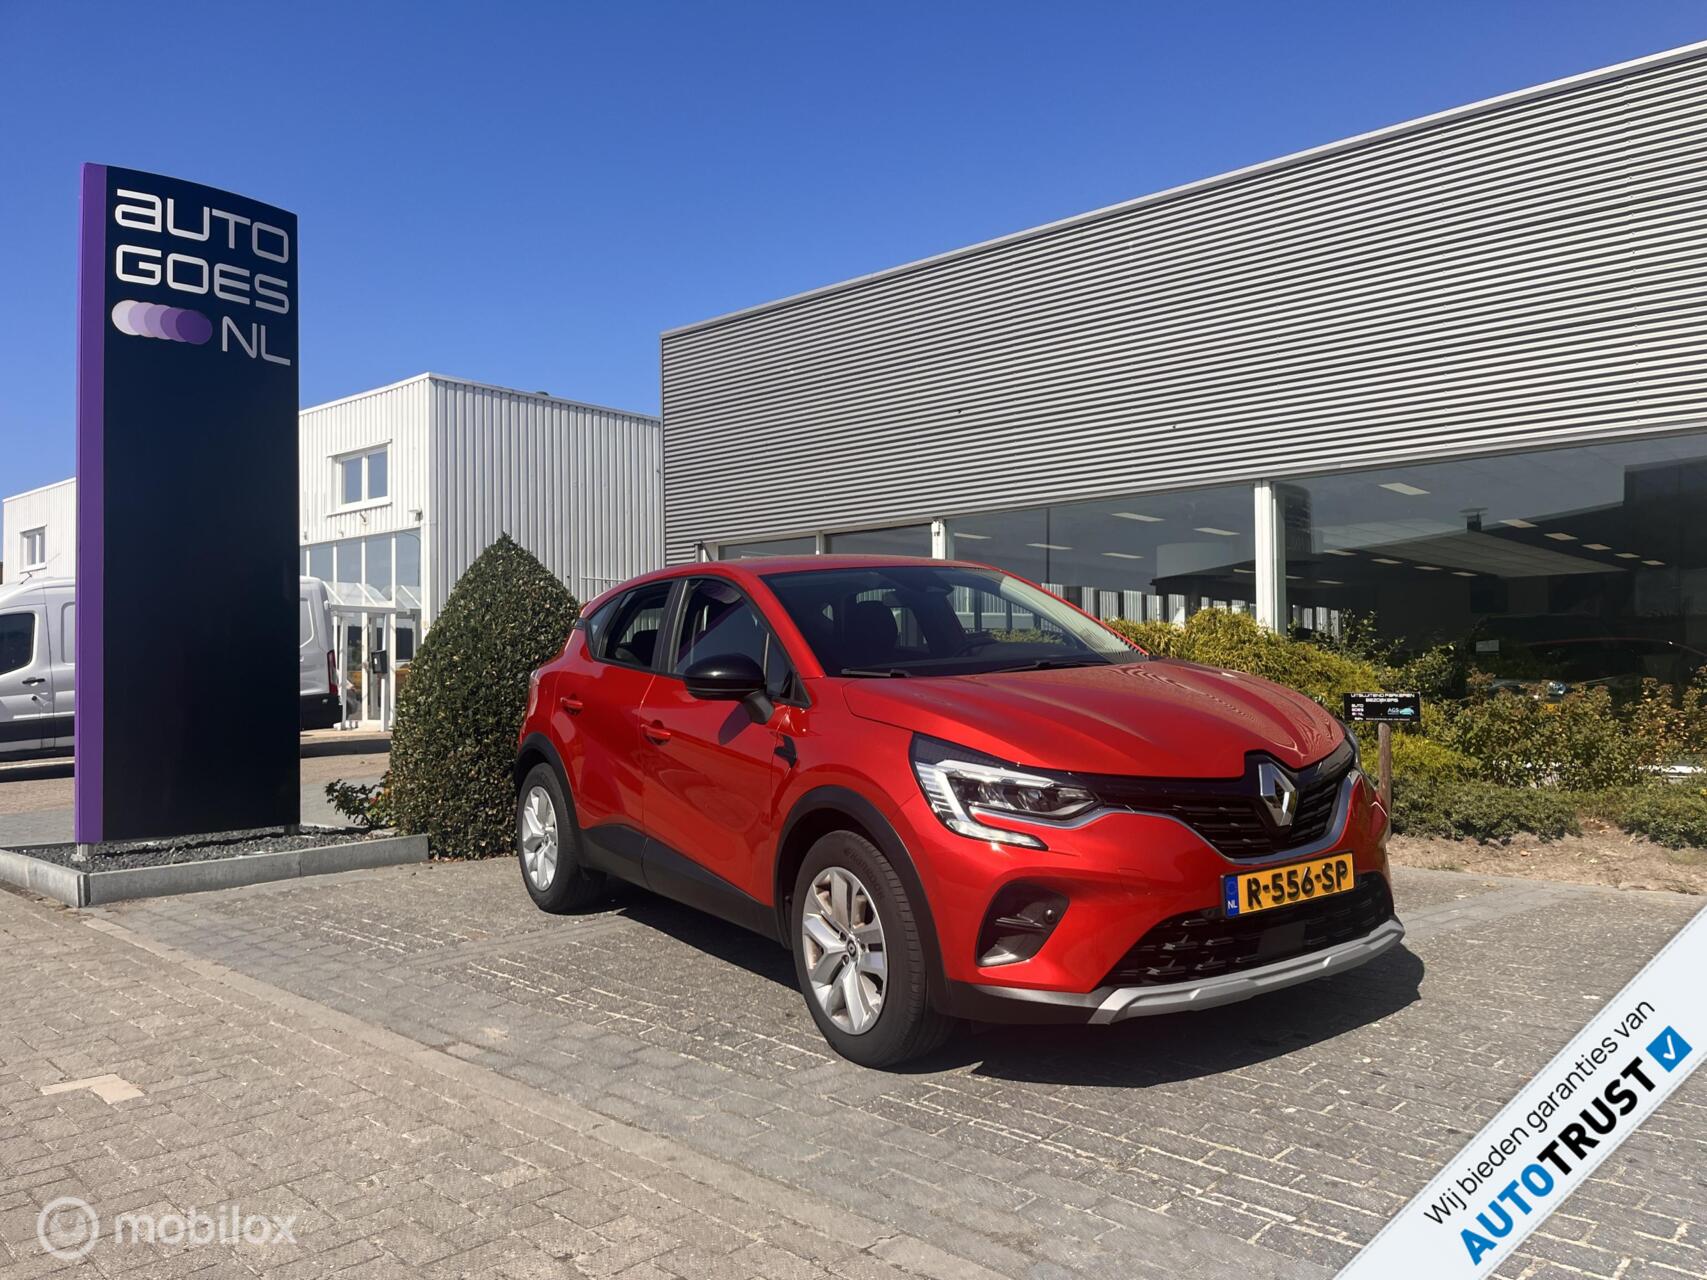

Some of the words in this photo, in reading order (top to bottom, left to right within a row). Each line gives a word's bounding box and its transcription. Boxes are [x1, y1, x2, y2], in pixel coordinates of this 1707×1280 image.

[116, 244, 290, 314] GOES
[222, 315, 291, 366] NL
[1227, 900, 1238, 909] NL
[1246, 859, 1348, 910] R-556-SP
